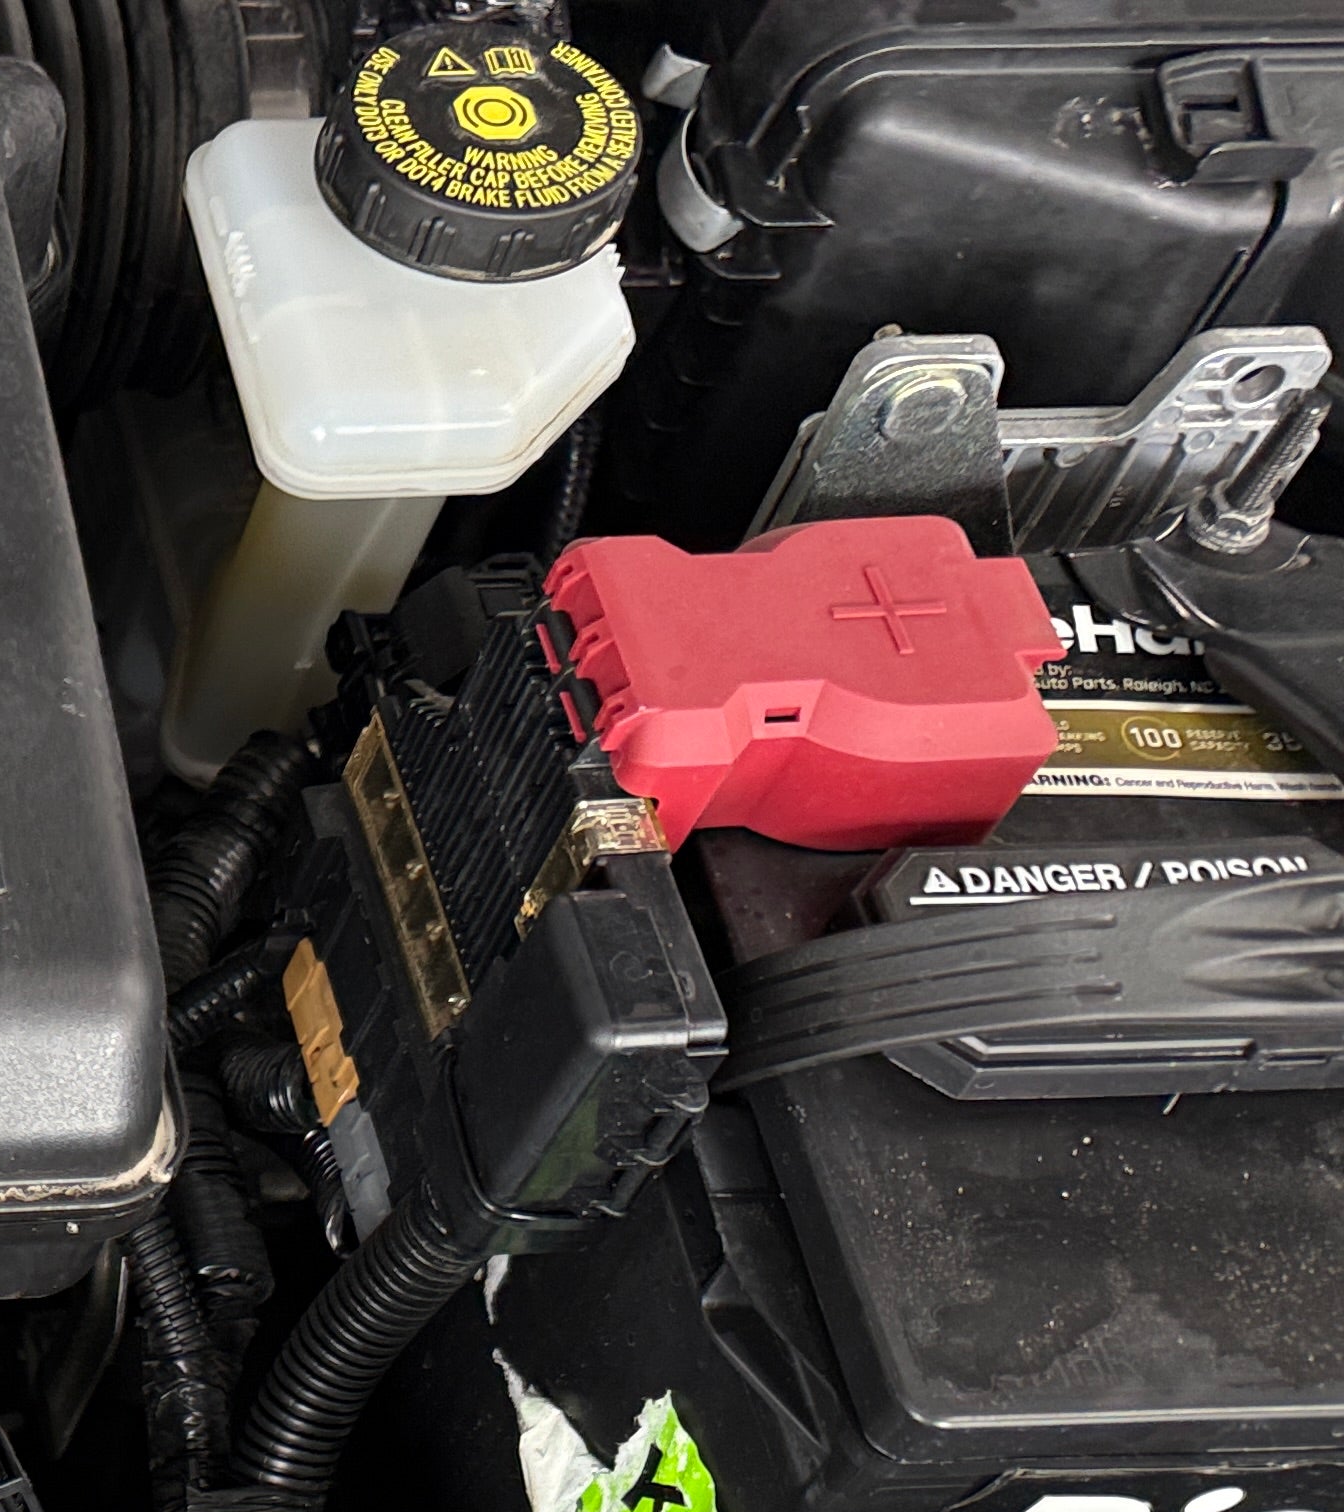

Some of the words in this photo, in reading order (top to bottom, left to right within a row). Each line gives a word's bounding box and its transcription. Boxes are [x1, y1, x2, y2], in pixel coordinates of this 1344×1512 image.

[364, 46, 401, 75] USE
[550, 40, 631, 109] CONTAINER
[353, 70, 383, 106] ONLY
[354, 106, 389, 142] DOT3
[606, 109, 637, 160] SEALED
[374, 140, 406, 164] OR
[380, 99, 420, 144] CLEAN
[406, 140, 468, 180] FILLER
[470, 167, 510, 188] CAP
[513, 154, 589, 189] BEFORE
[572, 92, 610, 163] REMOVING
[464, 144, 558, 171] WARNING
[601, 157, 626, 172] A
[395, 157, 447, 192] DOT4
[565, 162, 616, 198] FROM
[445, 179, 513, 207] BRAKE
[514, 184, 571, 209] FLUID
[1129, 727, 1183, 749] 100
[959, 863, 1127, 894] DANGER
